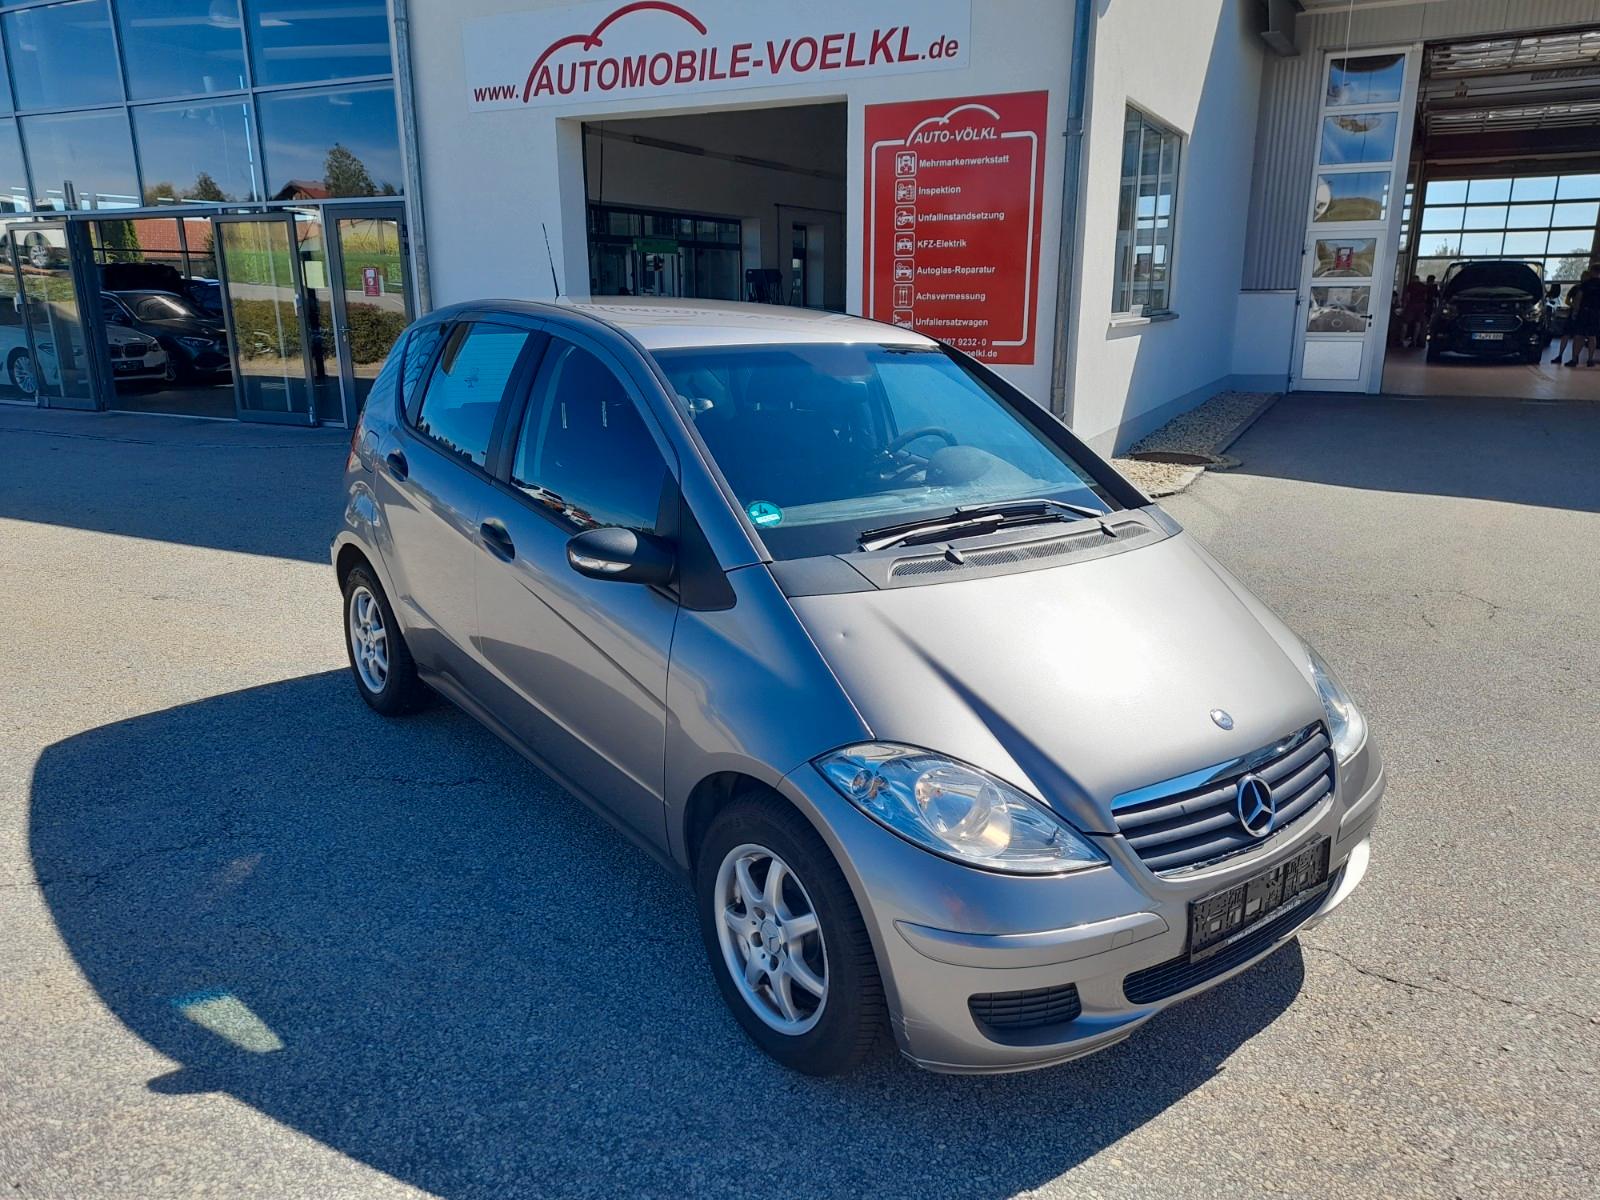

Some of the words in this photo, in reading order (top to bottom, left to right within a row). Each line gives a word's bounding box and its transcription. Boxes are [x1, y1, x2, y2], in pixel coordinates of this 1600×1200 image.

[914, 127, 997, 145] AUTO-VÖLKL
[919, 154, 1010, 168] Mehrmarkenwerkstatt
[918, 185, 961, 196] Inspektion
[917, 210, 1005, 222] Unfallinstandsetzung
[917, 239, 967, 249] KFZ-Elektrik
[916, 265, 996, 276] Autoglas-Reparatur
[915, 292, 986, 302] Achsvermessung
[915, 317, 989, 328] Unfallersatzwagen
